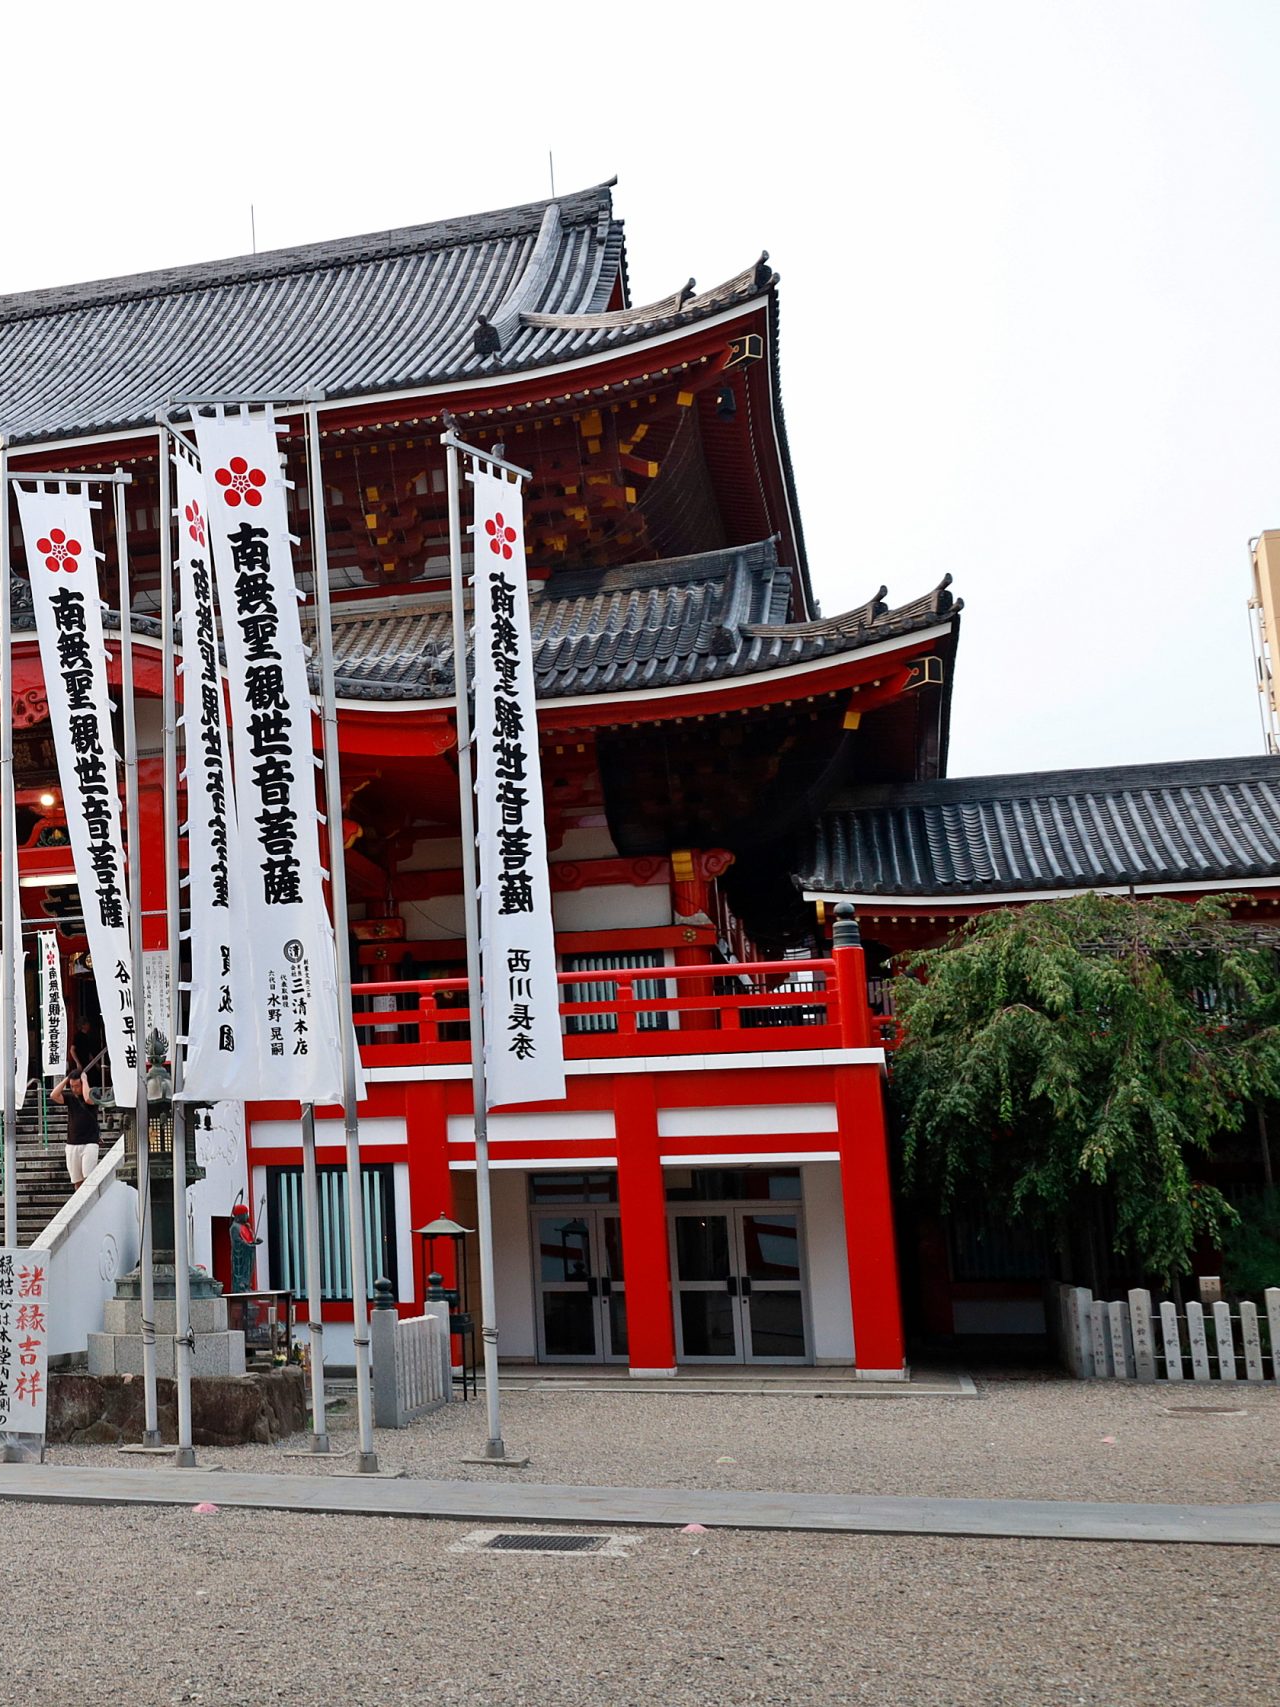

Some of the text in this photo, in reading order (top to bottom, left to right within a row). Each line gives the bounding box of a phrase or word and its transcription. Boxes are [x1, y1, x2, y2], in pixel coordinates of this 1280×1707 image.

[48, 587, 124, 929] 南無聖観世音菩薩
[227, 522, 304, 905] 南無聖観世音菩薩
[114, 959, 137, 1069] 谷川早苗
[280, 974, 289, 1008] 代表取締役
[291, 978, 309, 1055] 三清本店
[12, 1264, 47, 1408] 諸縁吉祥
